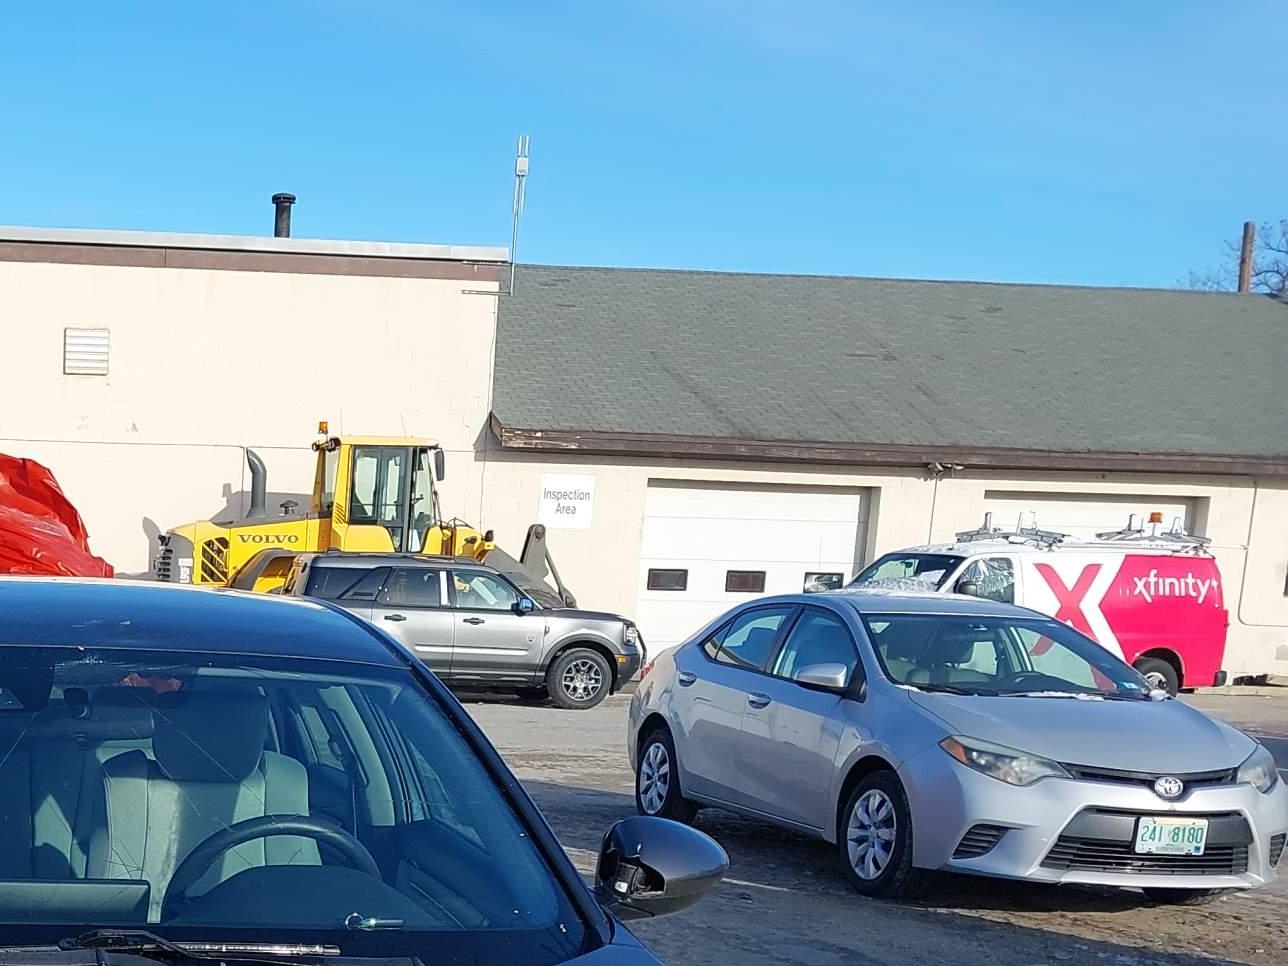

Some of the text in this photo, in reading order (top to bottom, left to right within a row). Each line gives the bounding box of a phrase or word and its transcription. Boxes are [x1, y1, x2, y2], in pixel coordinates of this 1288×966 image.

[543, 487, 591, 501] Inspection
[555, 502, 577, 515] Area
[238, 534, 299, 544] VOLVO
[1133, 568, 1211, 604] xfinity
[1140, 825, 1205, 844] 241 8180
